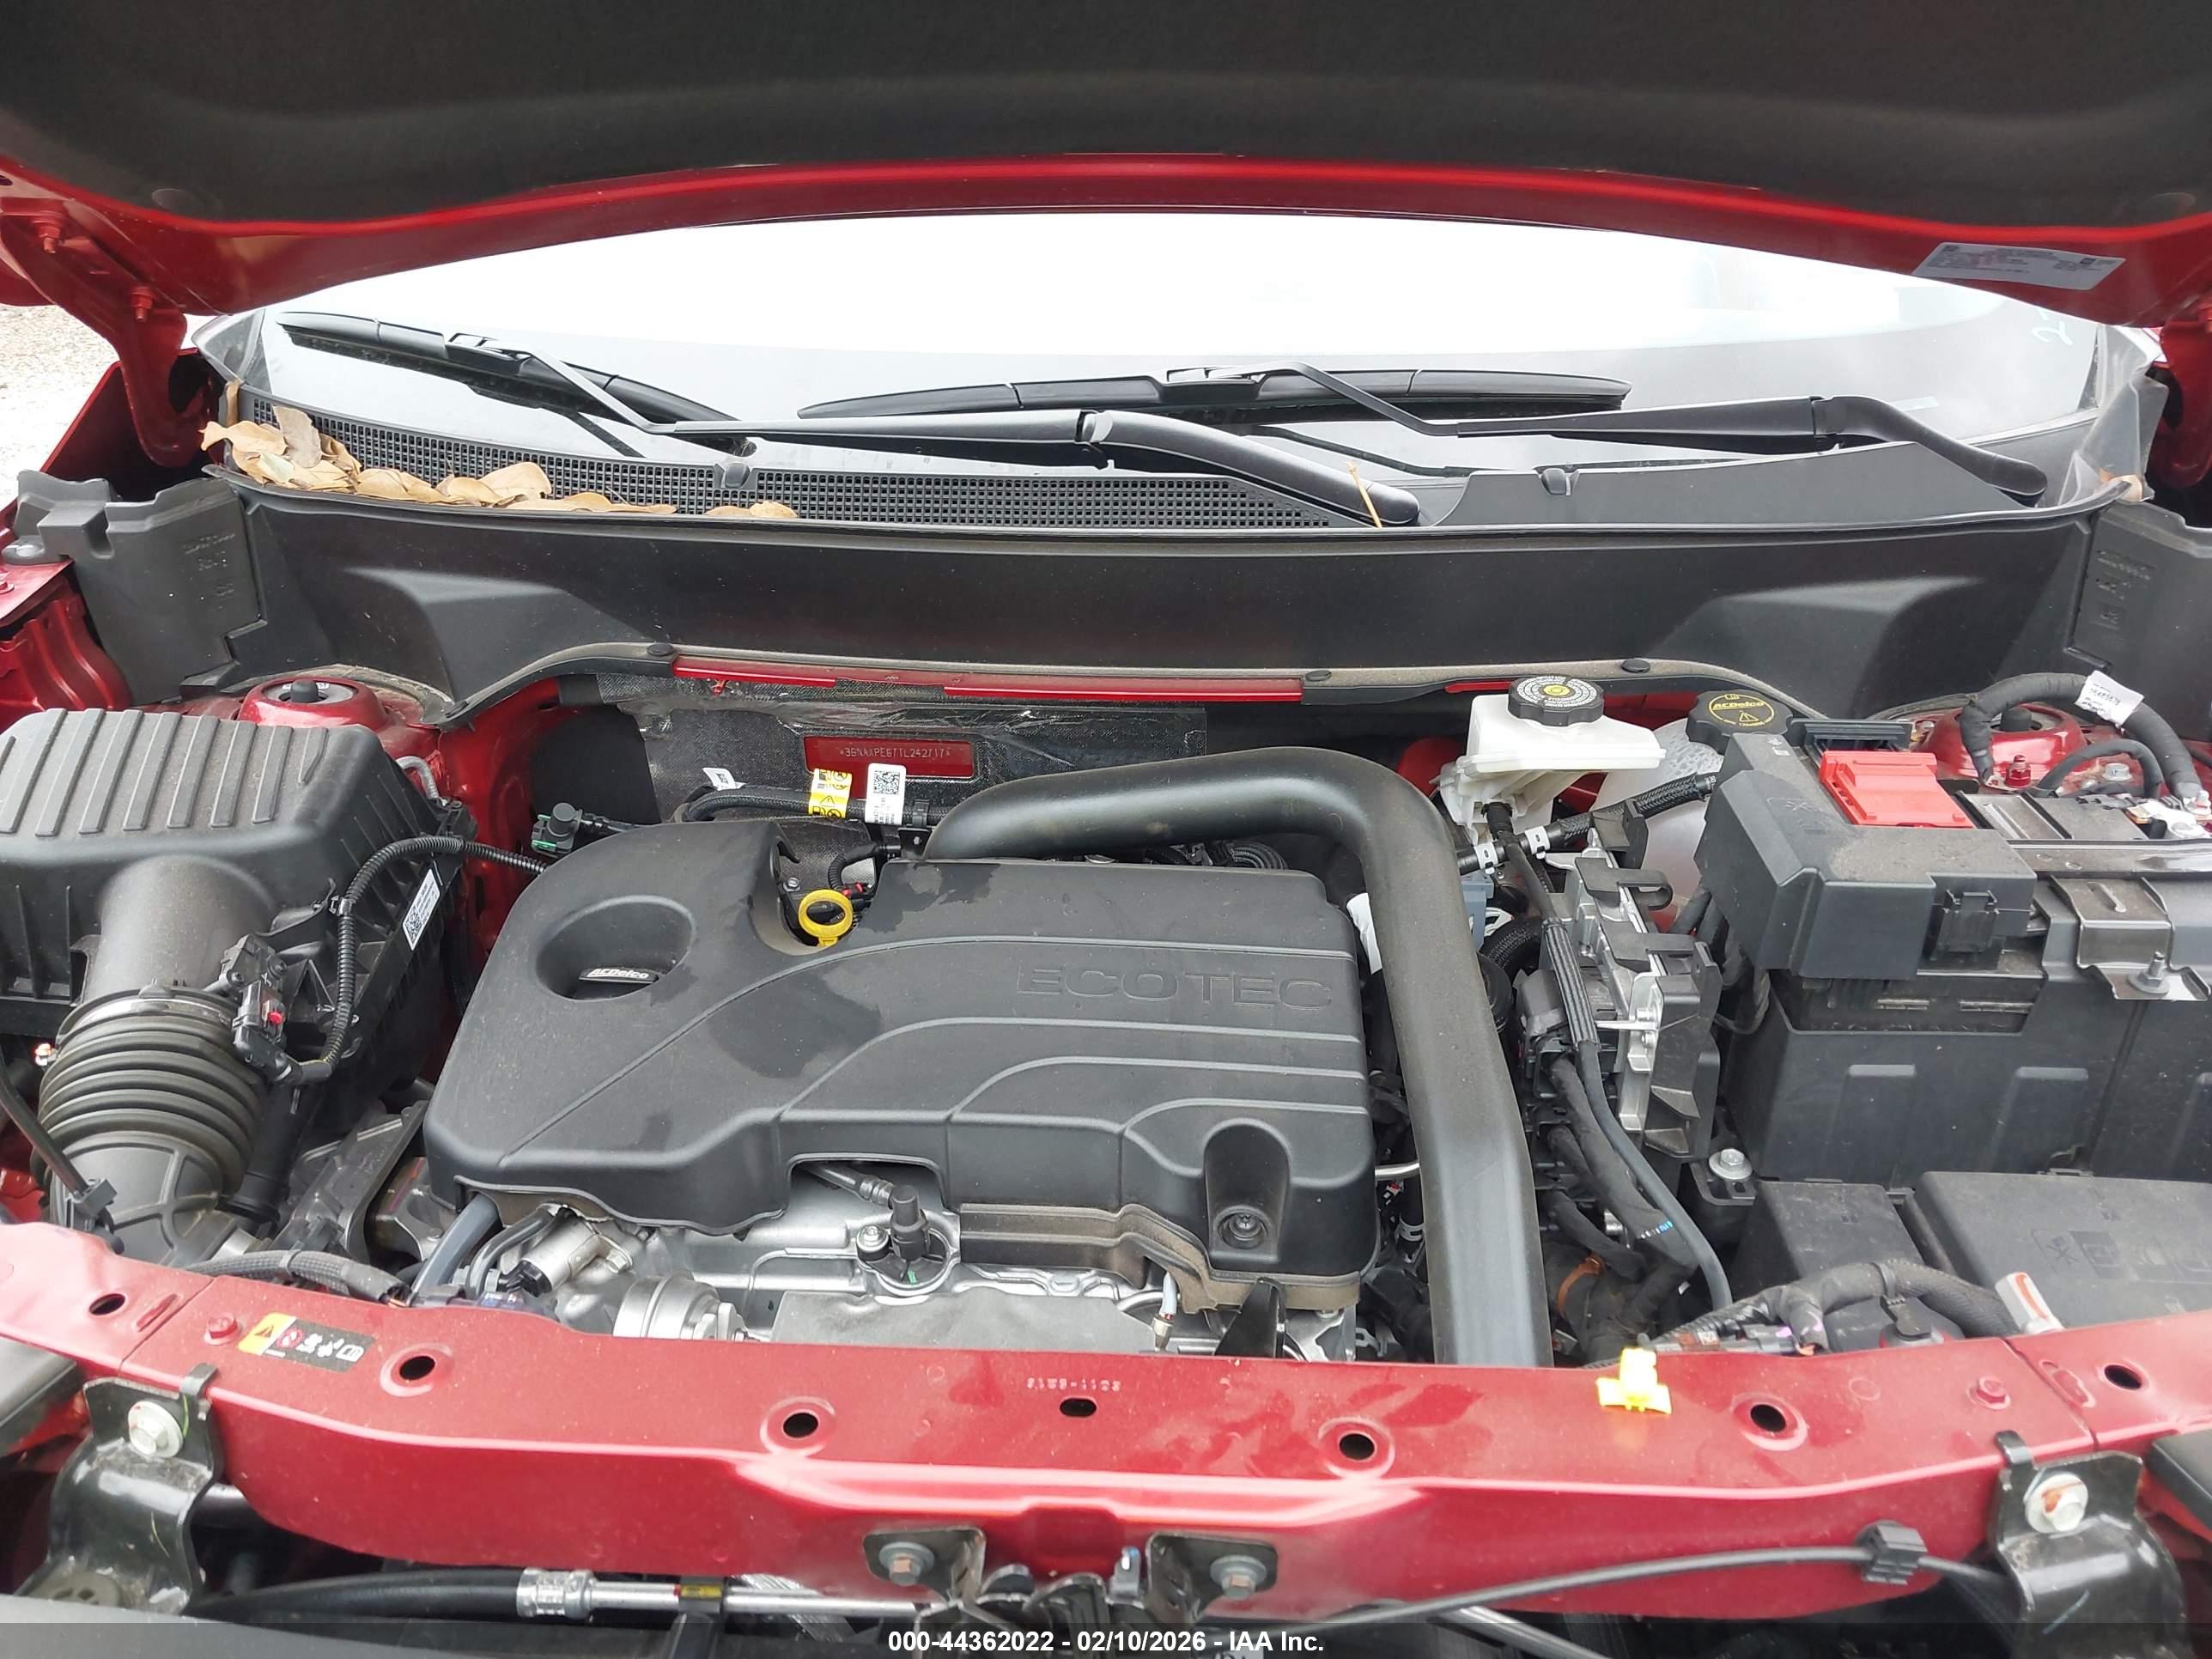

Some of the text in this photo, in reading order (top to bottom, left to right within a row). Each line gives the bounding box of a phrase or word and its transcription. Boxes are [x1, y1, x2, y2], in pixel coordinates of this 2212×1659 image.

[1712, 701, 1765, 711] ACDelco
[586, 968, 649, 979] ACDelco
[1017, 965, 1333, 1011] ECOTEC
